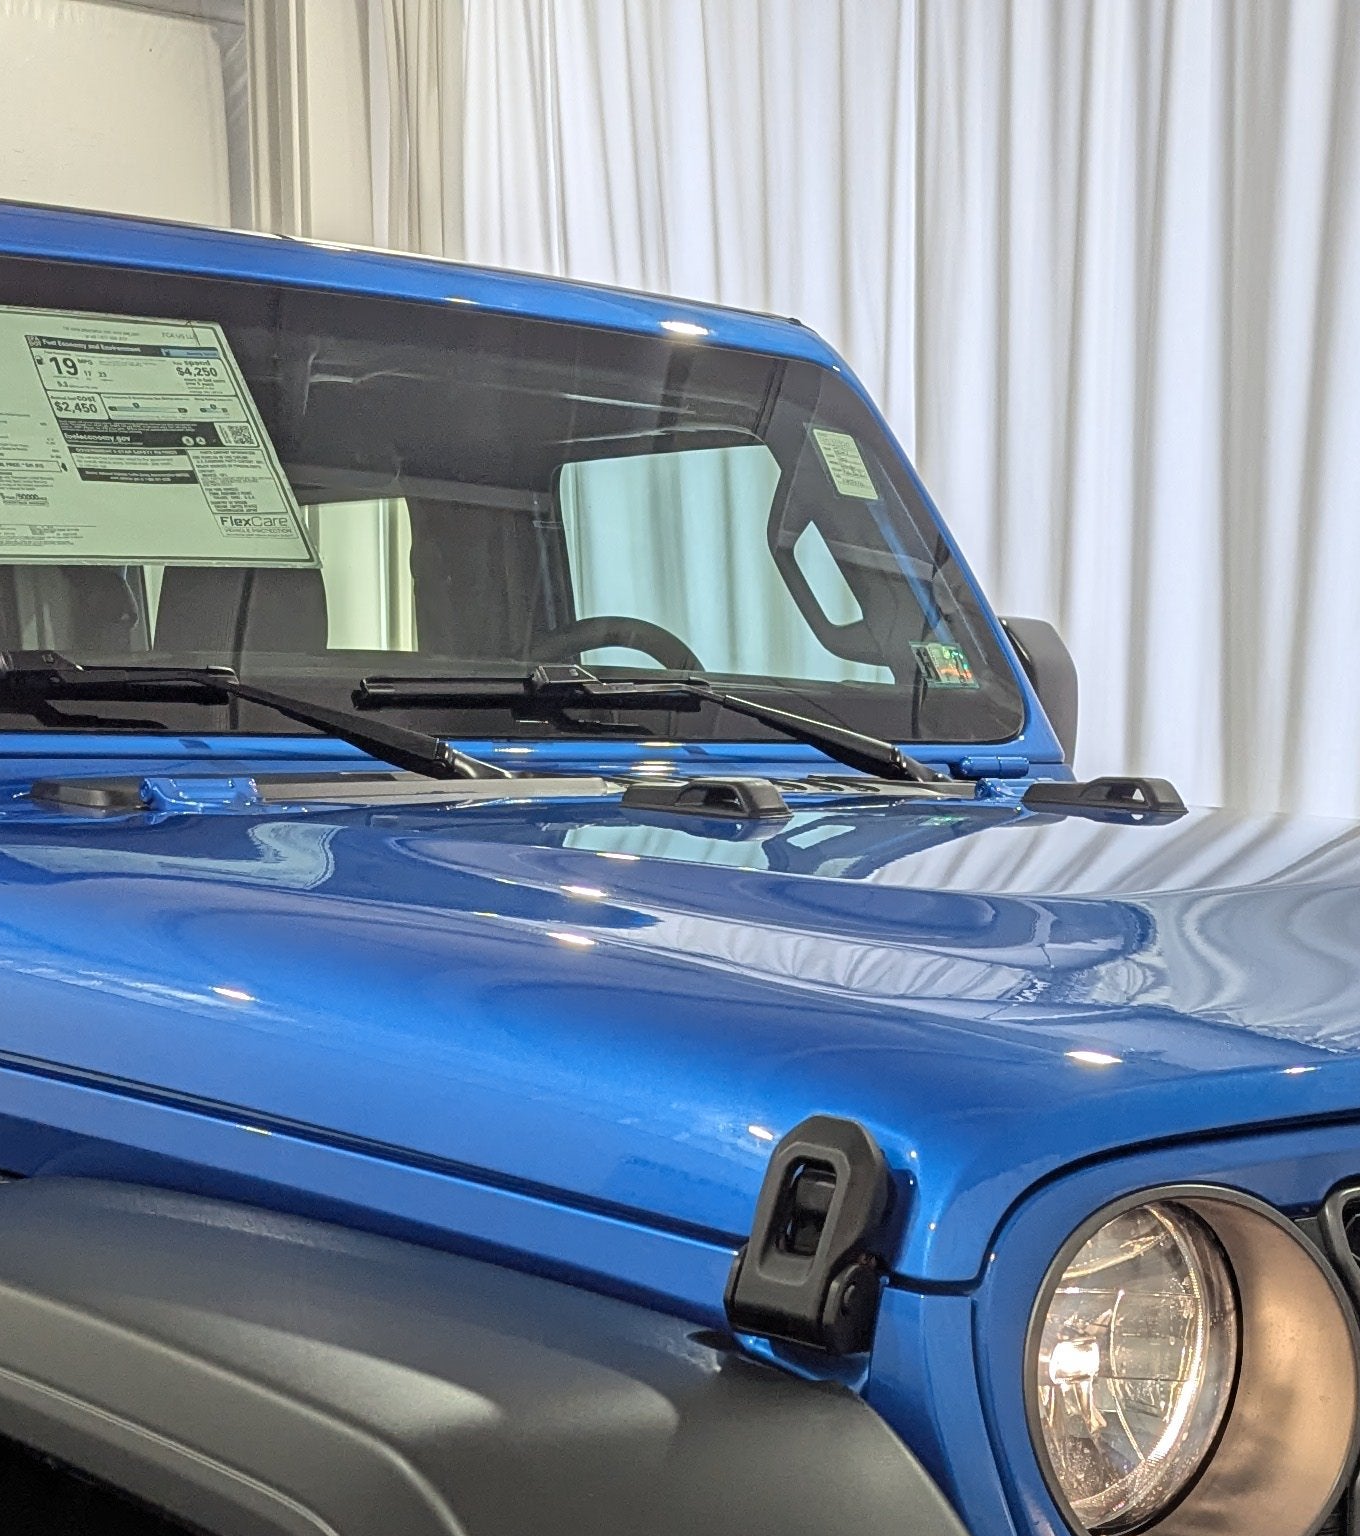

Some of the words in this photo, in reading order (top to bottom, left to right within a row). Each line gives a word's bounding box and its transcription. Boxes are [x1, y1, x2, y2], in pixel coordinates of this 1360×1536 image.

[49, 356, 79, 376] 19
[176, 366, 218, 378] $4,250
[54, 401, 98, 414] $2,450
[220, 515, 288, 527] FlexCare
